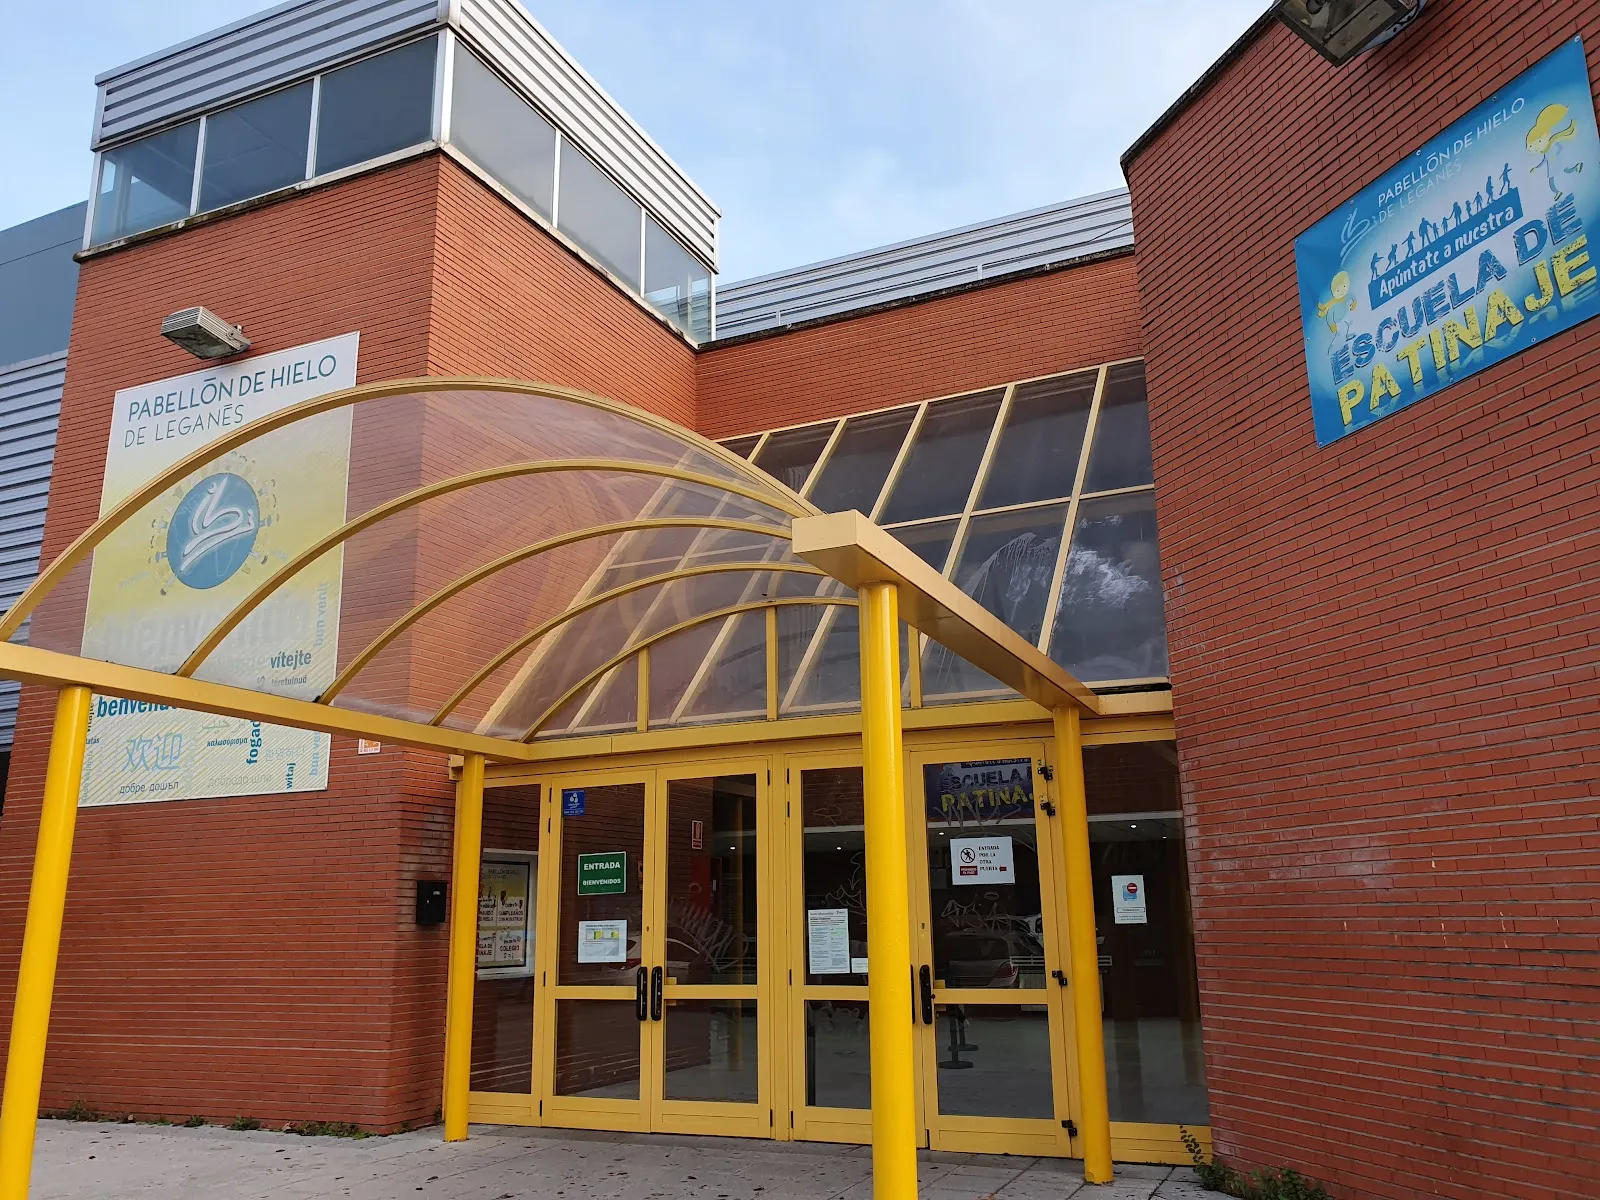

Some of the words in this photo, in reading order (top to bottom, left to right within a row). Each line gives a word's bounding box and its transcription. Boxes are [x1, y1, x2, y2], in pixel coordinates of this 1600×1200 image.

[1454, 131, 1473, 156] DE
[1477, 97, 1525, 141] HIELO
[1379, 207, 1395, 223] DE
[1443, 243, 1452, 256] a
[1454, 205, 1514, 250] nuestra
[1329, 248, 1507, 385] ESCUELA
[1513, 192, 1583, 267] DE
[1337, 234, 1598, 427] PATINAJE
[239, 371, 266, 397] DE
[270, 354, 337, 390] HIELO
[124, 426, 146, 448] DE
[270, 649, 312, 671] vítejte
[122, 732, 183, 773] 欢迎
[286, 762, 296, 789] witaj
[941, 768, 1023, 792] ESCUELA
[941, 785, 1033, 812] PATINA
[584, 861, 621, 871] ENTRADA
[582, 878, 621, 886] BIENVENIDOS
